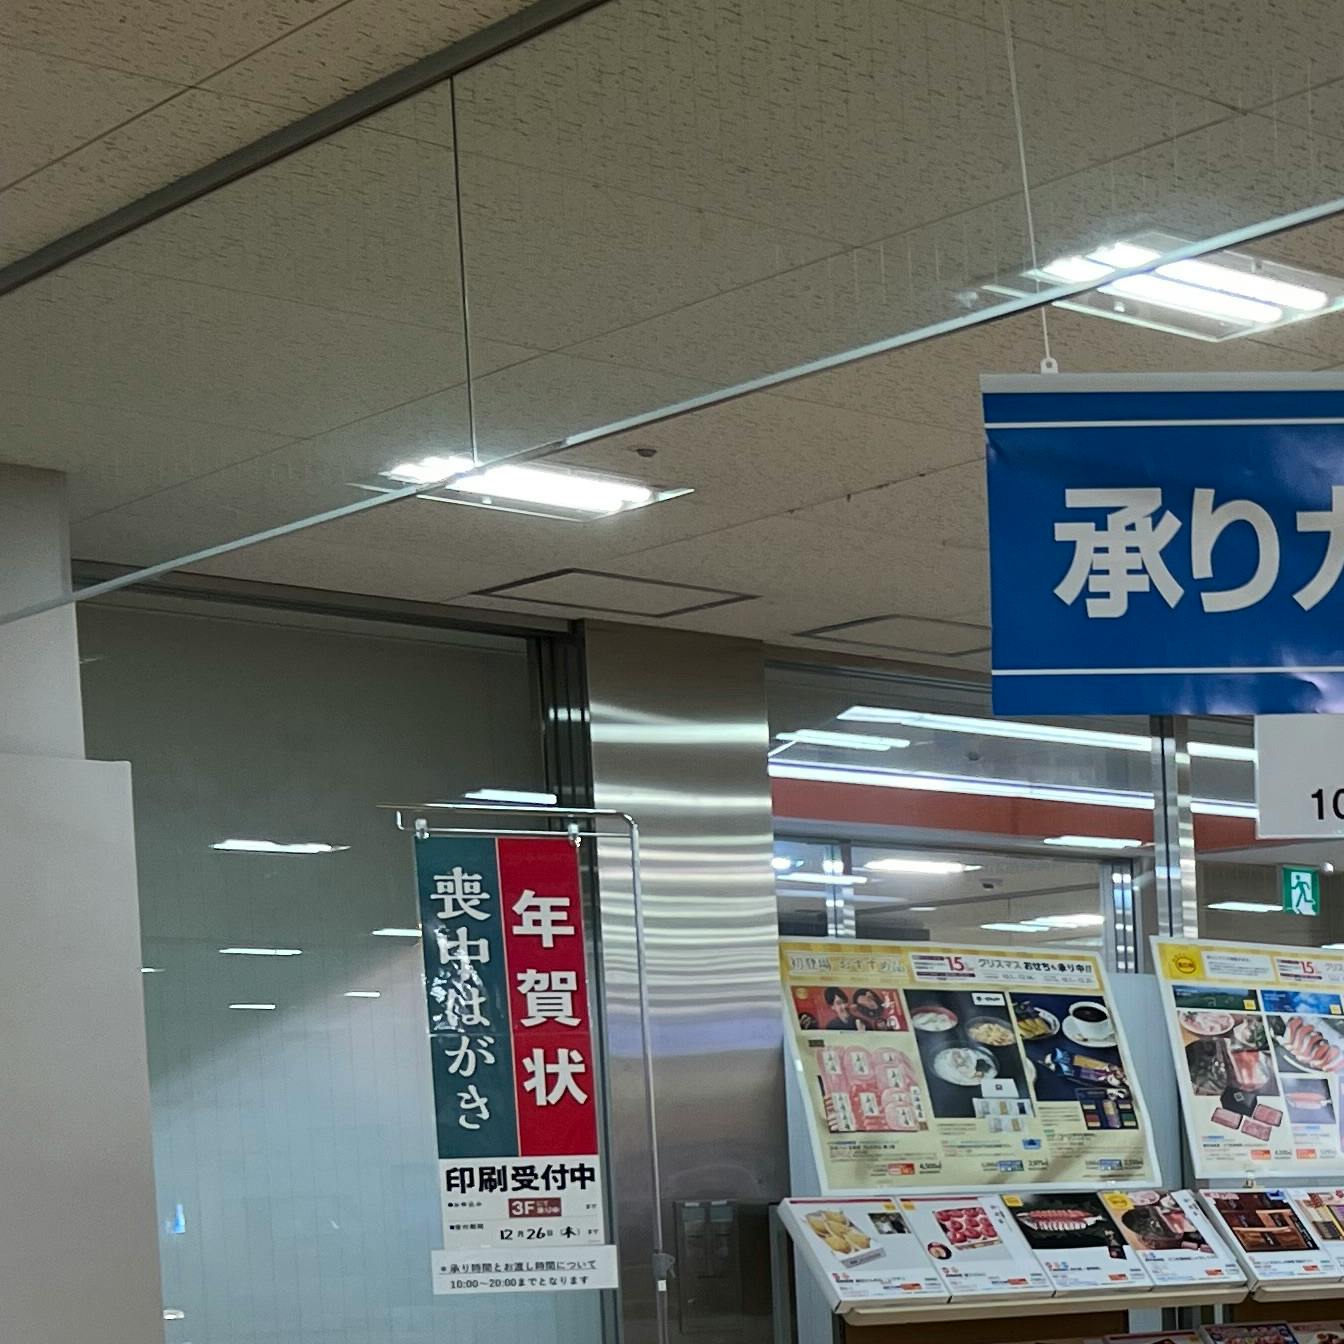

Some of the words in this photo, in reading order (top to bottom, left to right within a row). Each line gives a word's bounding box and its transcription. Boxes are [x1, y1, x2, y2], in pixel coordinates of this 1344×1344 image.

[429, 866, 496, 1130] 喪中はがき
[511, 889, 589, 1107] 年賀状
[444, 1162, 596, 1194] 印刷受付中
[511, 1200, 536, 1216] 3F
[450, 1259, 598, 1275] 承り時間とお渡し時間について
